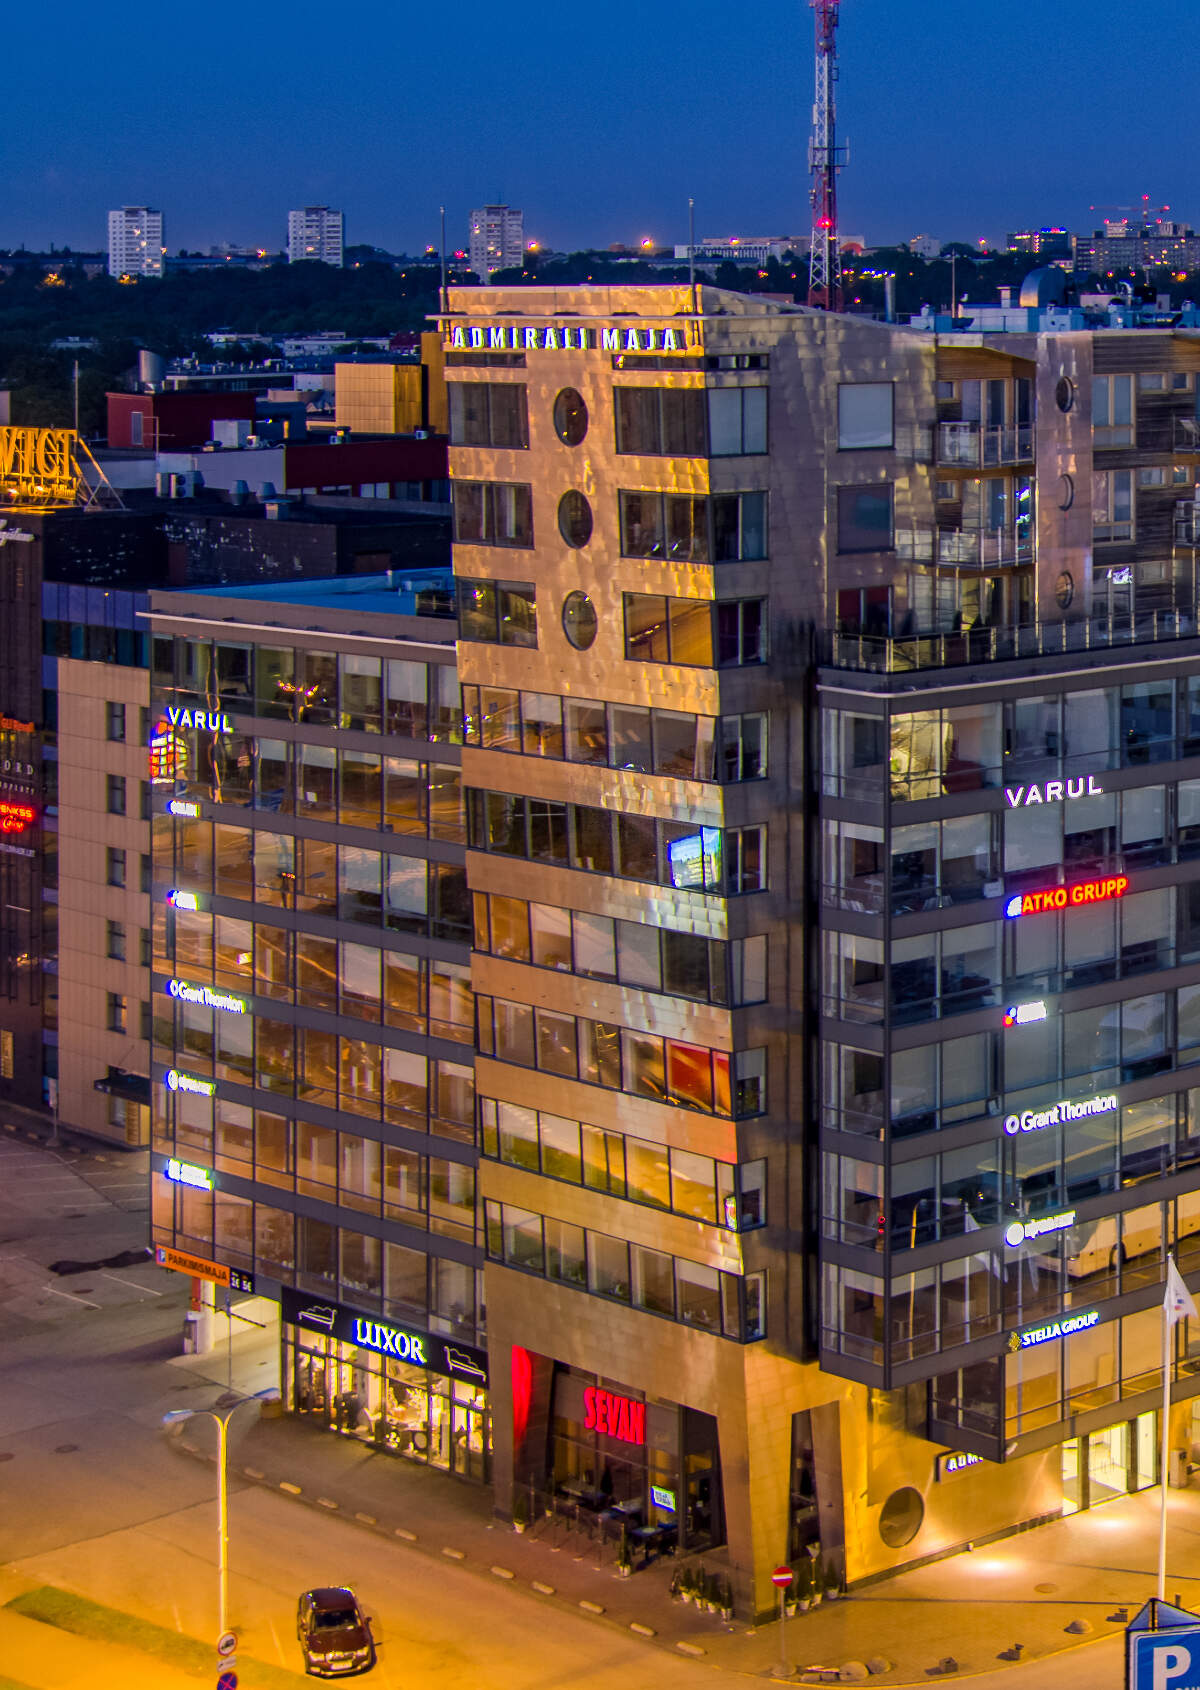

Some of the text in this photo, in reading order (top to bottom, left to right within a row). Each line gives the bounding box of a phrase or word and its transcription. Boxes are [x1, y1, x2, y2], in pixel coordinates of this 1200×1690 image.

[452, 326, 678, 351] ADMIRALI MAJA
[166, 706, 235, 733] VARUL
[1005, 775, 1104, 808] VARUL
[1022, 877, 1128, 914] ATKO GRUPP
[1020, 1106, 1060, 1132] Grant
[354, 1318, 428, 1363] LUXOR
[1022, 1311, 1099, 1347] STELLA GROUP
[583, 1386, 645, 1445] SEVAN
[1152, 1646, 1192, 1690] P
